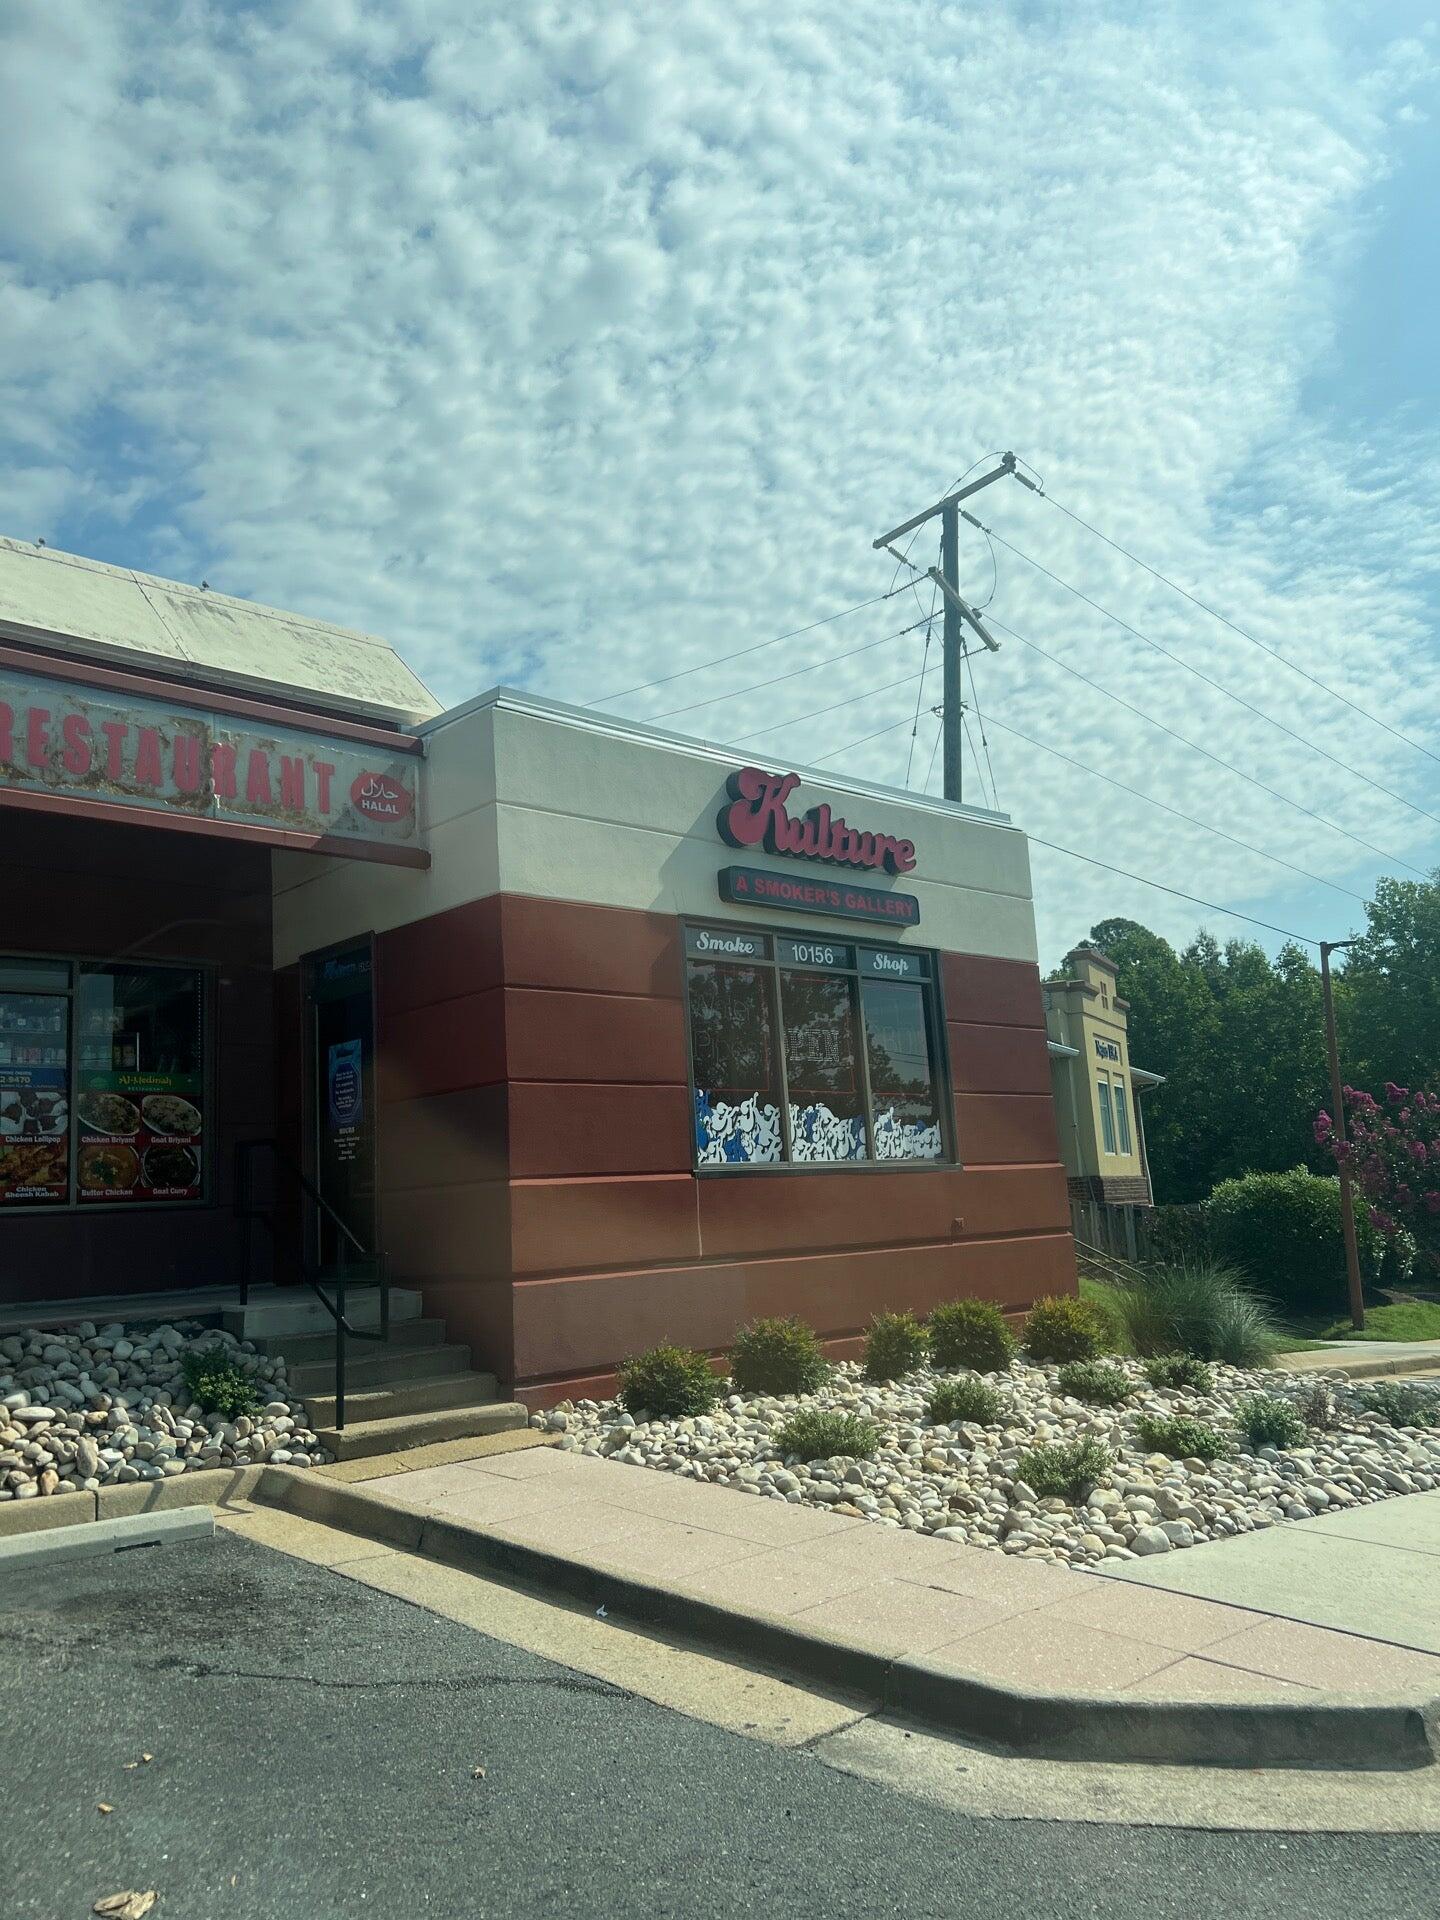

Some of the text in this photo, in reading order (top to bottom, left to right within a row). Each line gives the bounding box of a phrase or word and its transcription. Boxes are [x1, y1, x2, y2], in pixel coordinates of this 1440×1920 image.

[361, 778, 399, 799] حلال
[361, 799, 400, 815] HALAL
[721, 766, 917, 873] Kulture
[735, 876, 914, 918] A SMOKER'S GALLERY
[697, 931, 753, 954] Smoke
[791, 944, 833, 965] 10156
[872, 953, 908, 975] Shop
[81, 1136, 110, 1144] Chicken
[105, 1189, 134, 1197] Chicken
